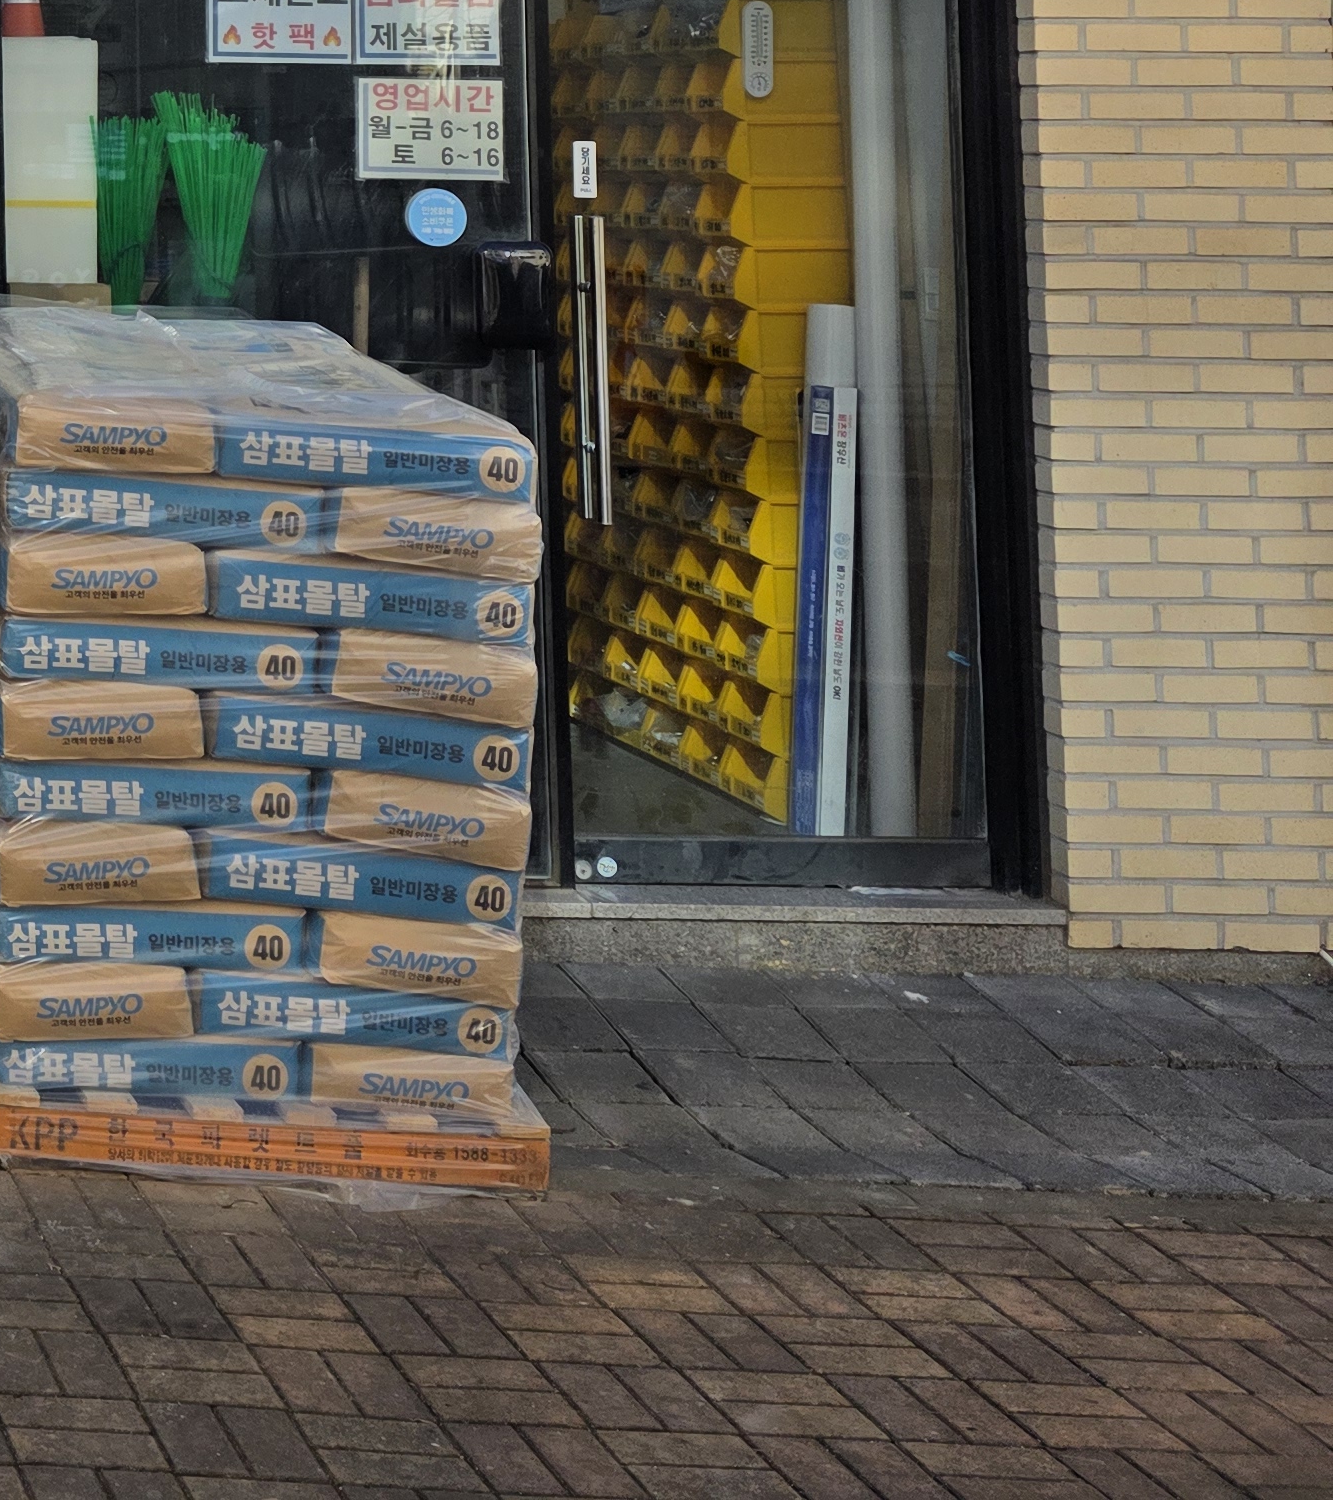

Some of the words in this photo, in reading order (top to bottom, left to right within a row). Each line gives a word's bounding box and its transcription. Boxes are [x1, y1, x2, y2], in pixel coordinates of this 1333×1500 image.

[251, 22, 277, 50] 핫
[289, 23, 315, 50] 팩
[370, 22, 492, 51] 제설용품
[372, 82, 495, 113] 영업시간
[369, 115, 433, 141] 월-금
[440, 121, 500, 140] 6~18
[391, 144, 416, 165] 토
[441, 147, 500, 167] 6~16
[581, 147, 590, 184] 당기세요
[240, 432, 372, 474] 삼표몰탈
[384, 451, 471, 474] 일반미장용
[487, 456, 518, 483] 40
[384, 517, 494, 548] SAMPYO
[19, 635, 151, 676] 삼표몰탈
[160, 651, 248, 674] 일반미장용
[264, 655, 296, 682] 40
[380, 661, 492, 699] SAMPYO
[12, 776, 143, 816] 삼표몰탈
[155, 790, 242, 813] 일반미장용
[258, 793, 290, 820] 40
[373, 803, 485, 840] SAMPYO
[365, 945, 477, 979] SAMPYO
[218, 991, 351, 1035] 삼표몰탈
[465, 1018, 497, 1046] 40
[358, 1073, 469, 1100] SAMPYO
[8, 1116, 78, 1152] KPP
